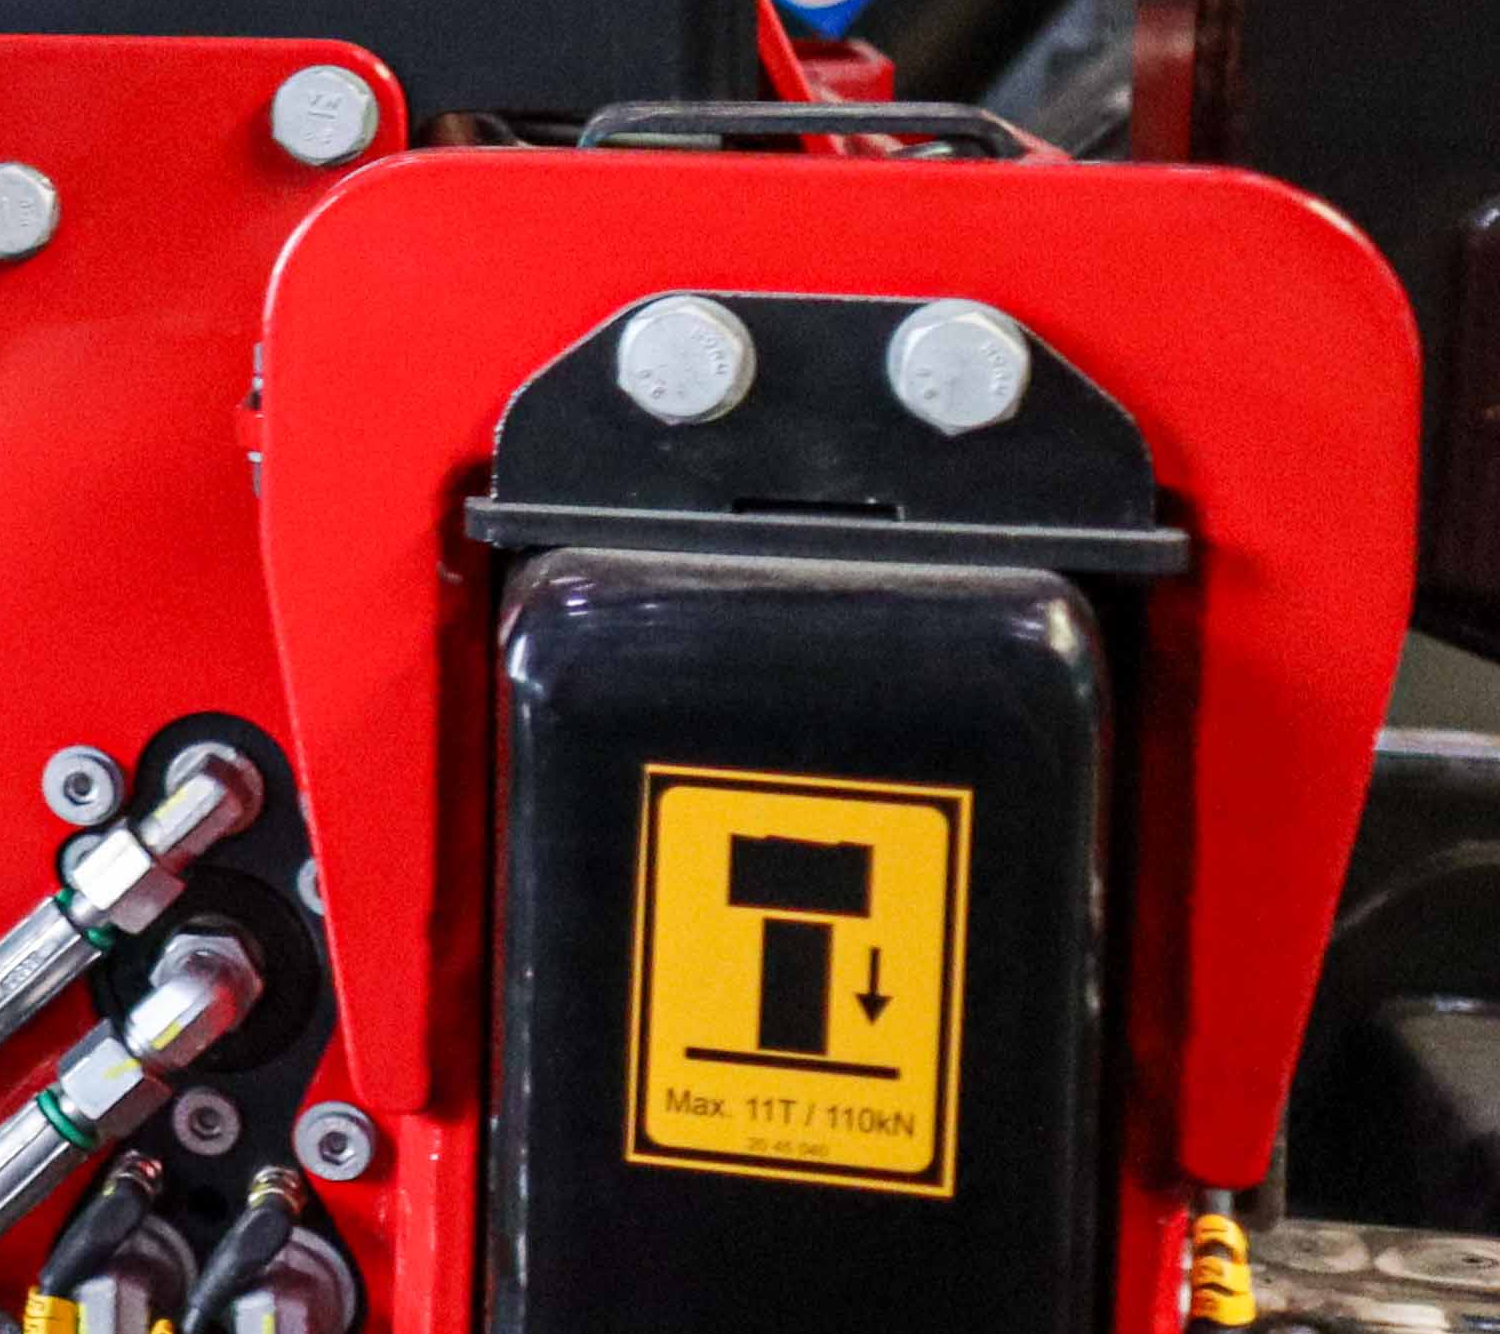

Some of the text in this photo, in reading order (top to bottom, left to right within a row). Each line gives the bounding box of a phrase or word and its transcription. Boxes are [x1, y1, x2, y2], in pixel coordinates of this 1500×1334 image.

[665, 1088, 916, 1138] Max. 11T / 110kN
